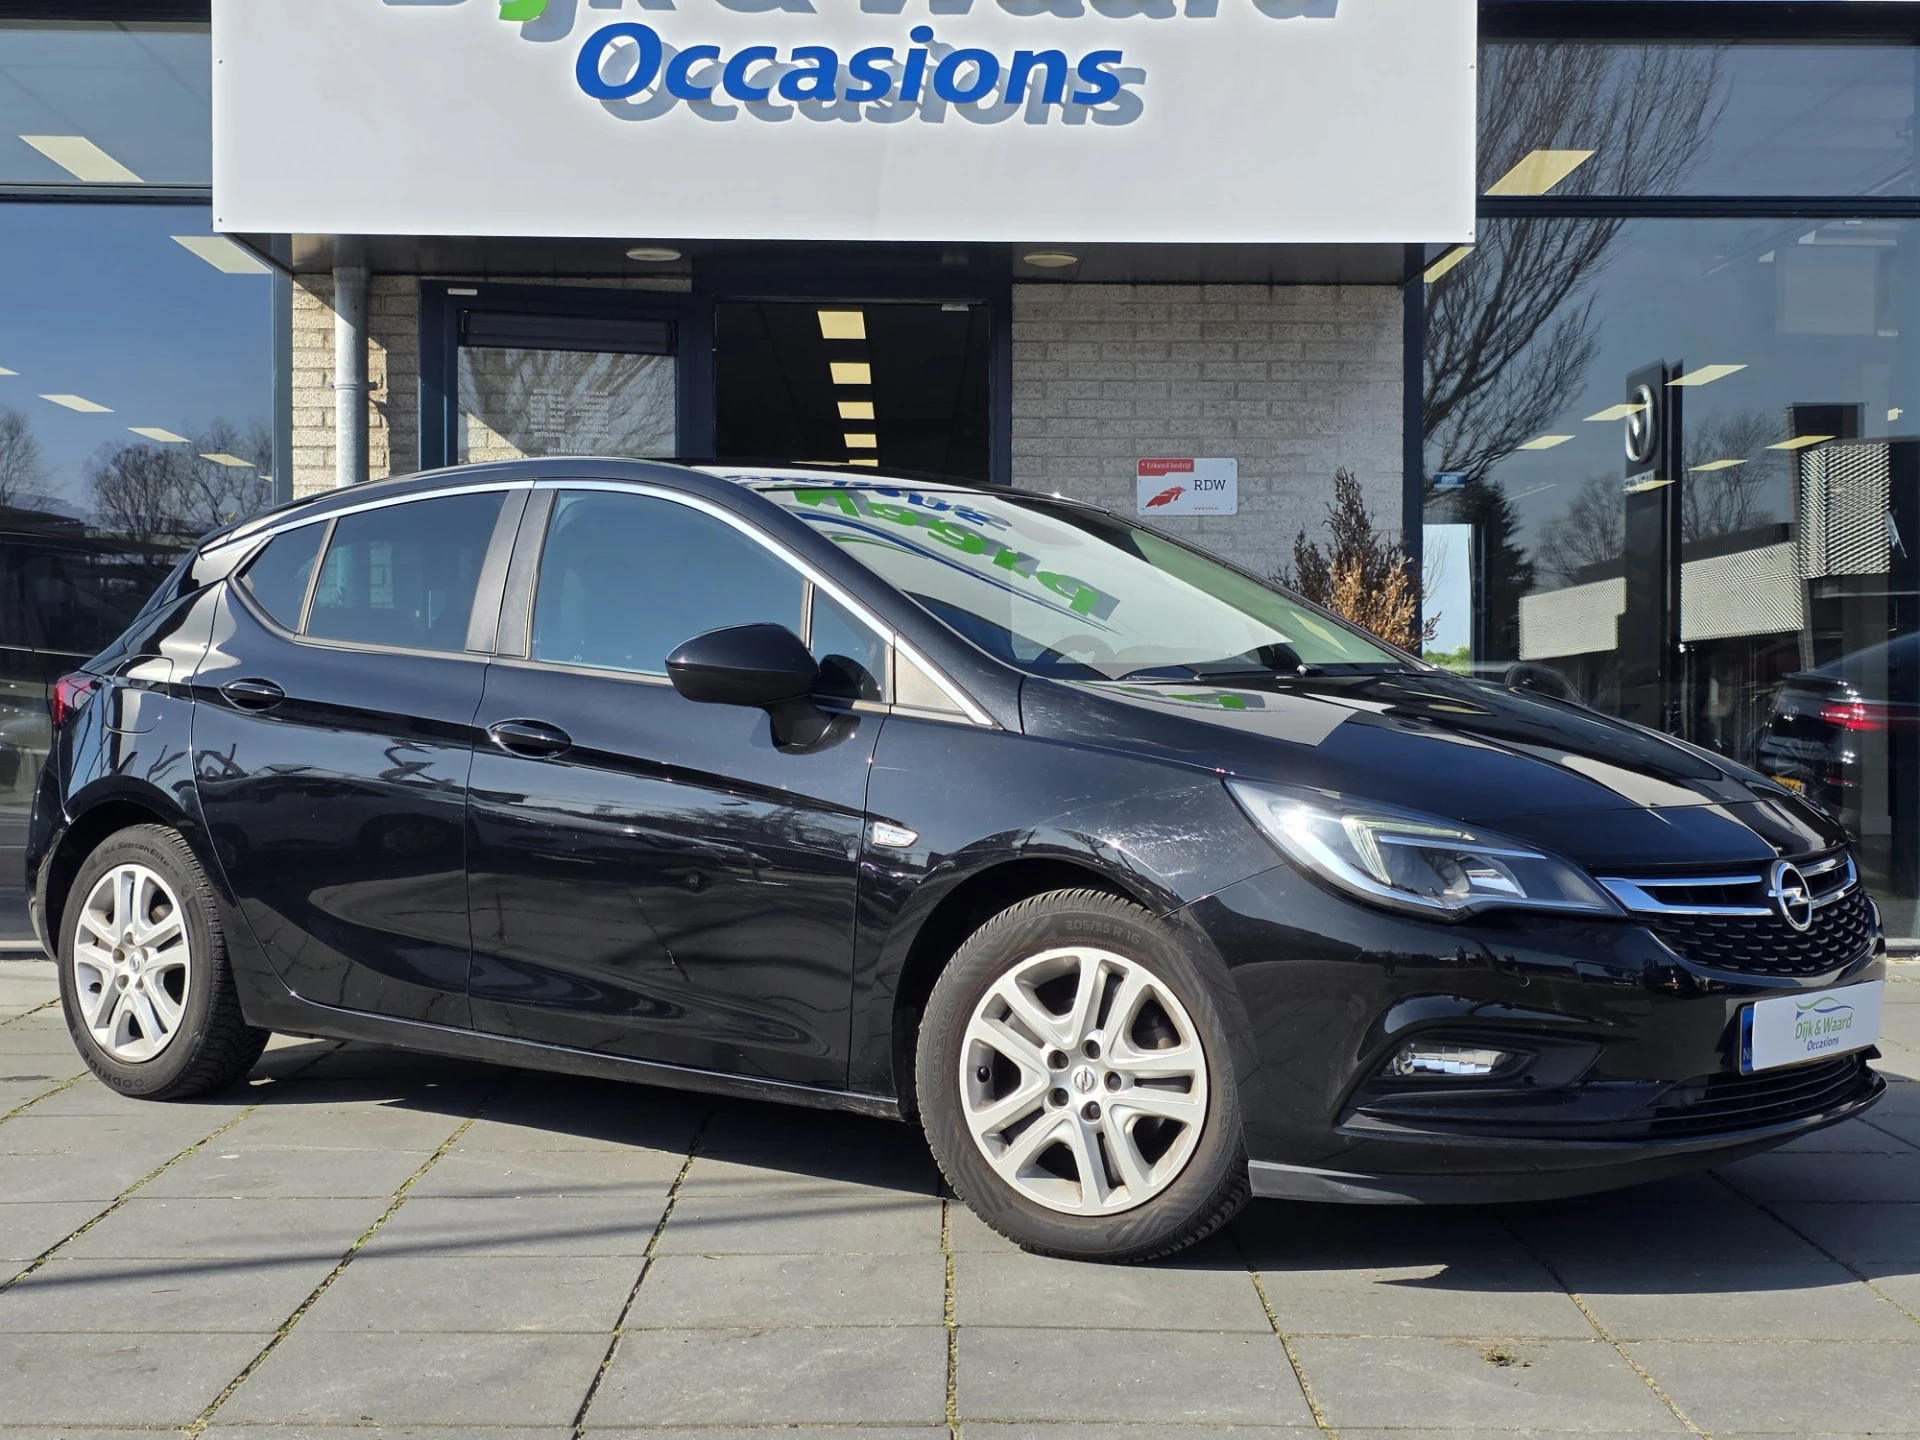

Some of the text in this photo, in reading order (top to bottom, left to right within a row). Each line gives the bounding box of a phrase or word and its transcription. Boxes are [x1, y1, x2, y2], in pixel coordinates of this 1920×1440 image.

[575, 21, 1123, 105] Occasions
[1194, 479, 1226, 491] RDW
[1065, 920, 1141, 945] 205/55 R 16
[1795, 1011, 1853, 1042] Dijk & Waard
[1807, 1036, 1840, 1051] Occasions
